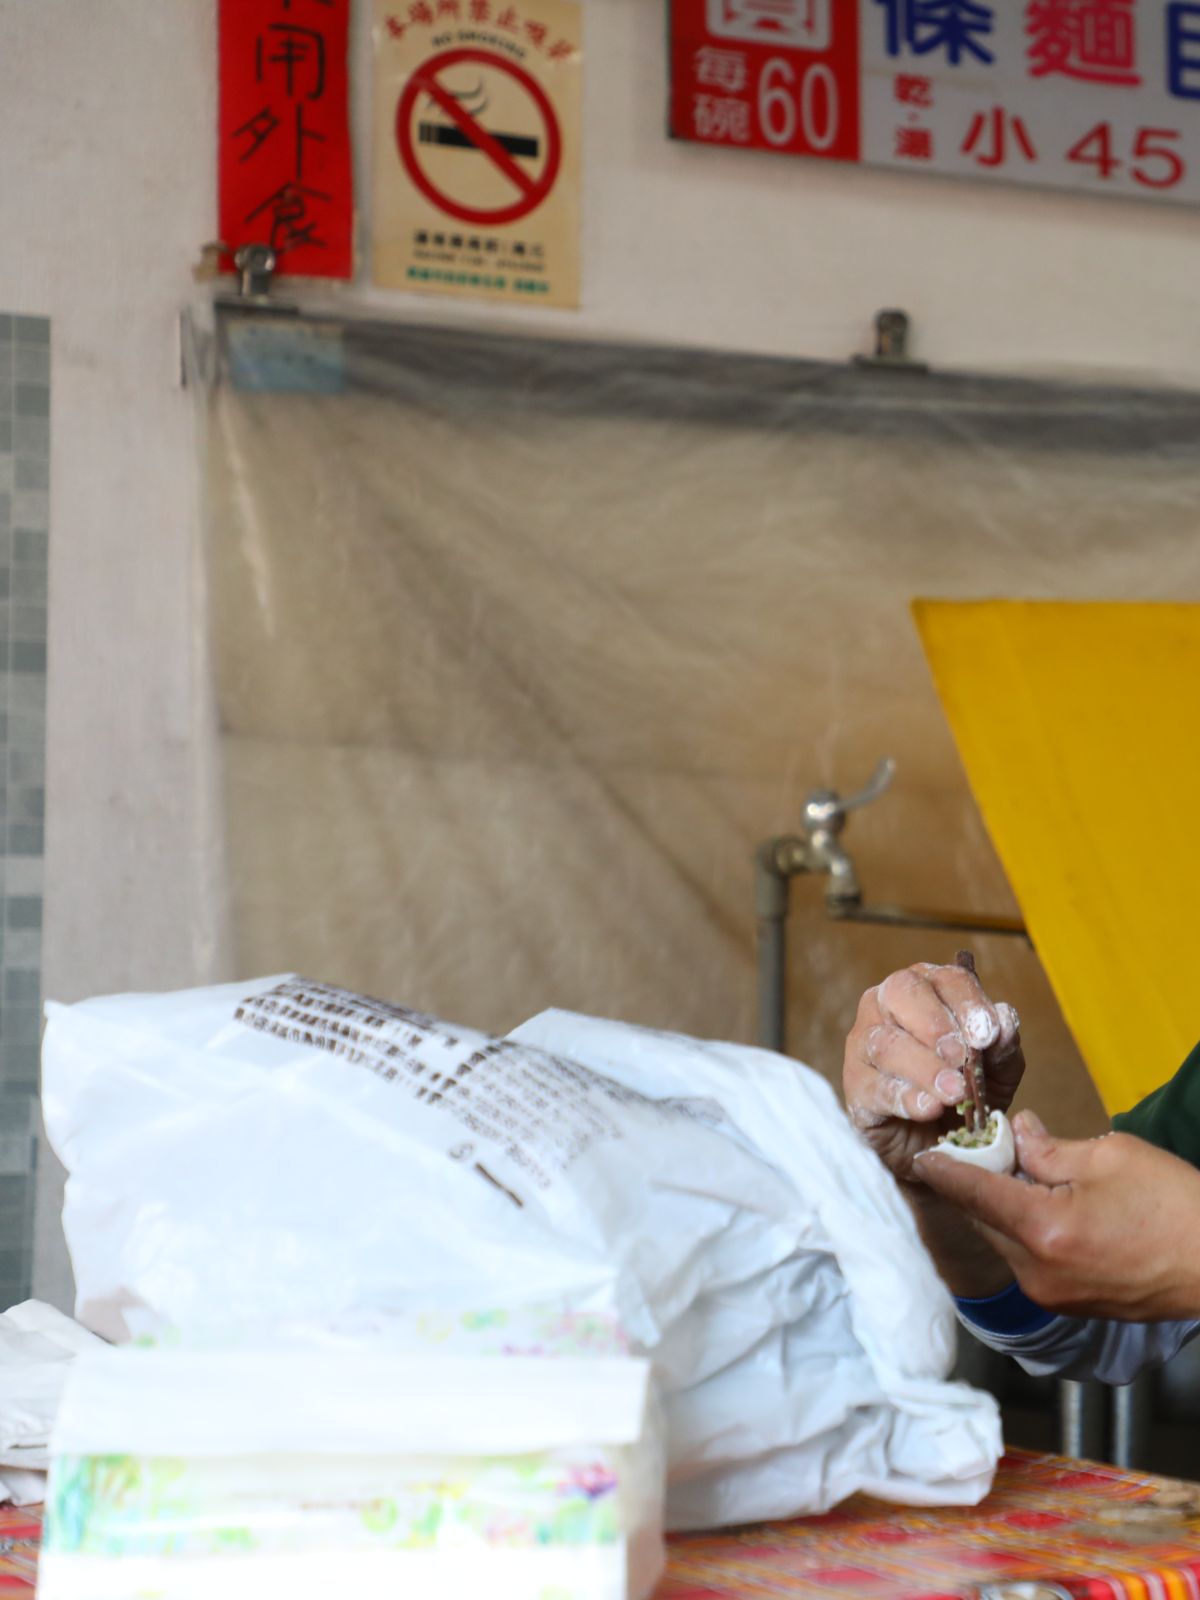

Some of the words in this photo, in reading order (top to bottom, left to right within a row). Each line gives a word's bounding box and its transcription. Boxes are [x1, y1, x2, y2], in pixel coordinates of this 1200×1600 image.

[694, 47, 750, 141] 每碗
[758, 57, 839, 150] 60
[960, 106, 1038, 168] 小
[1065, 120, 1185, 190] 45
